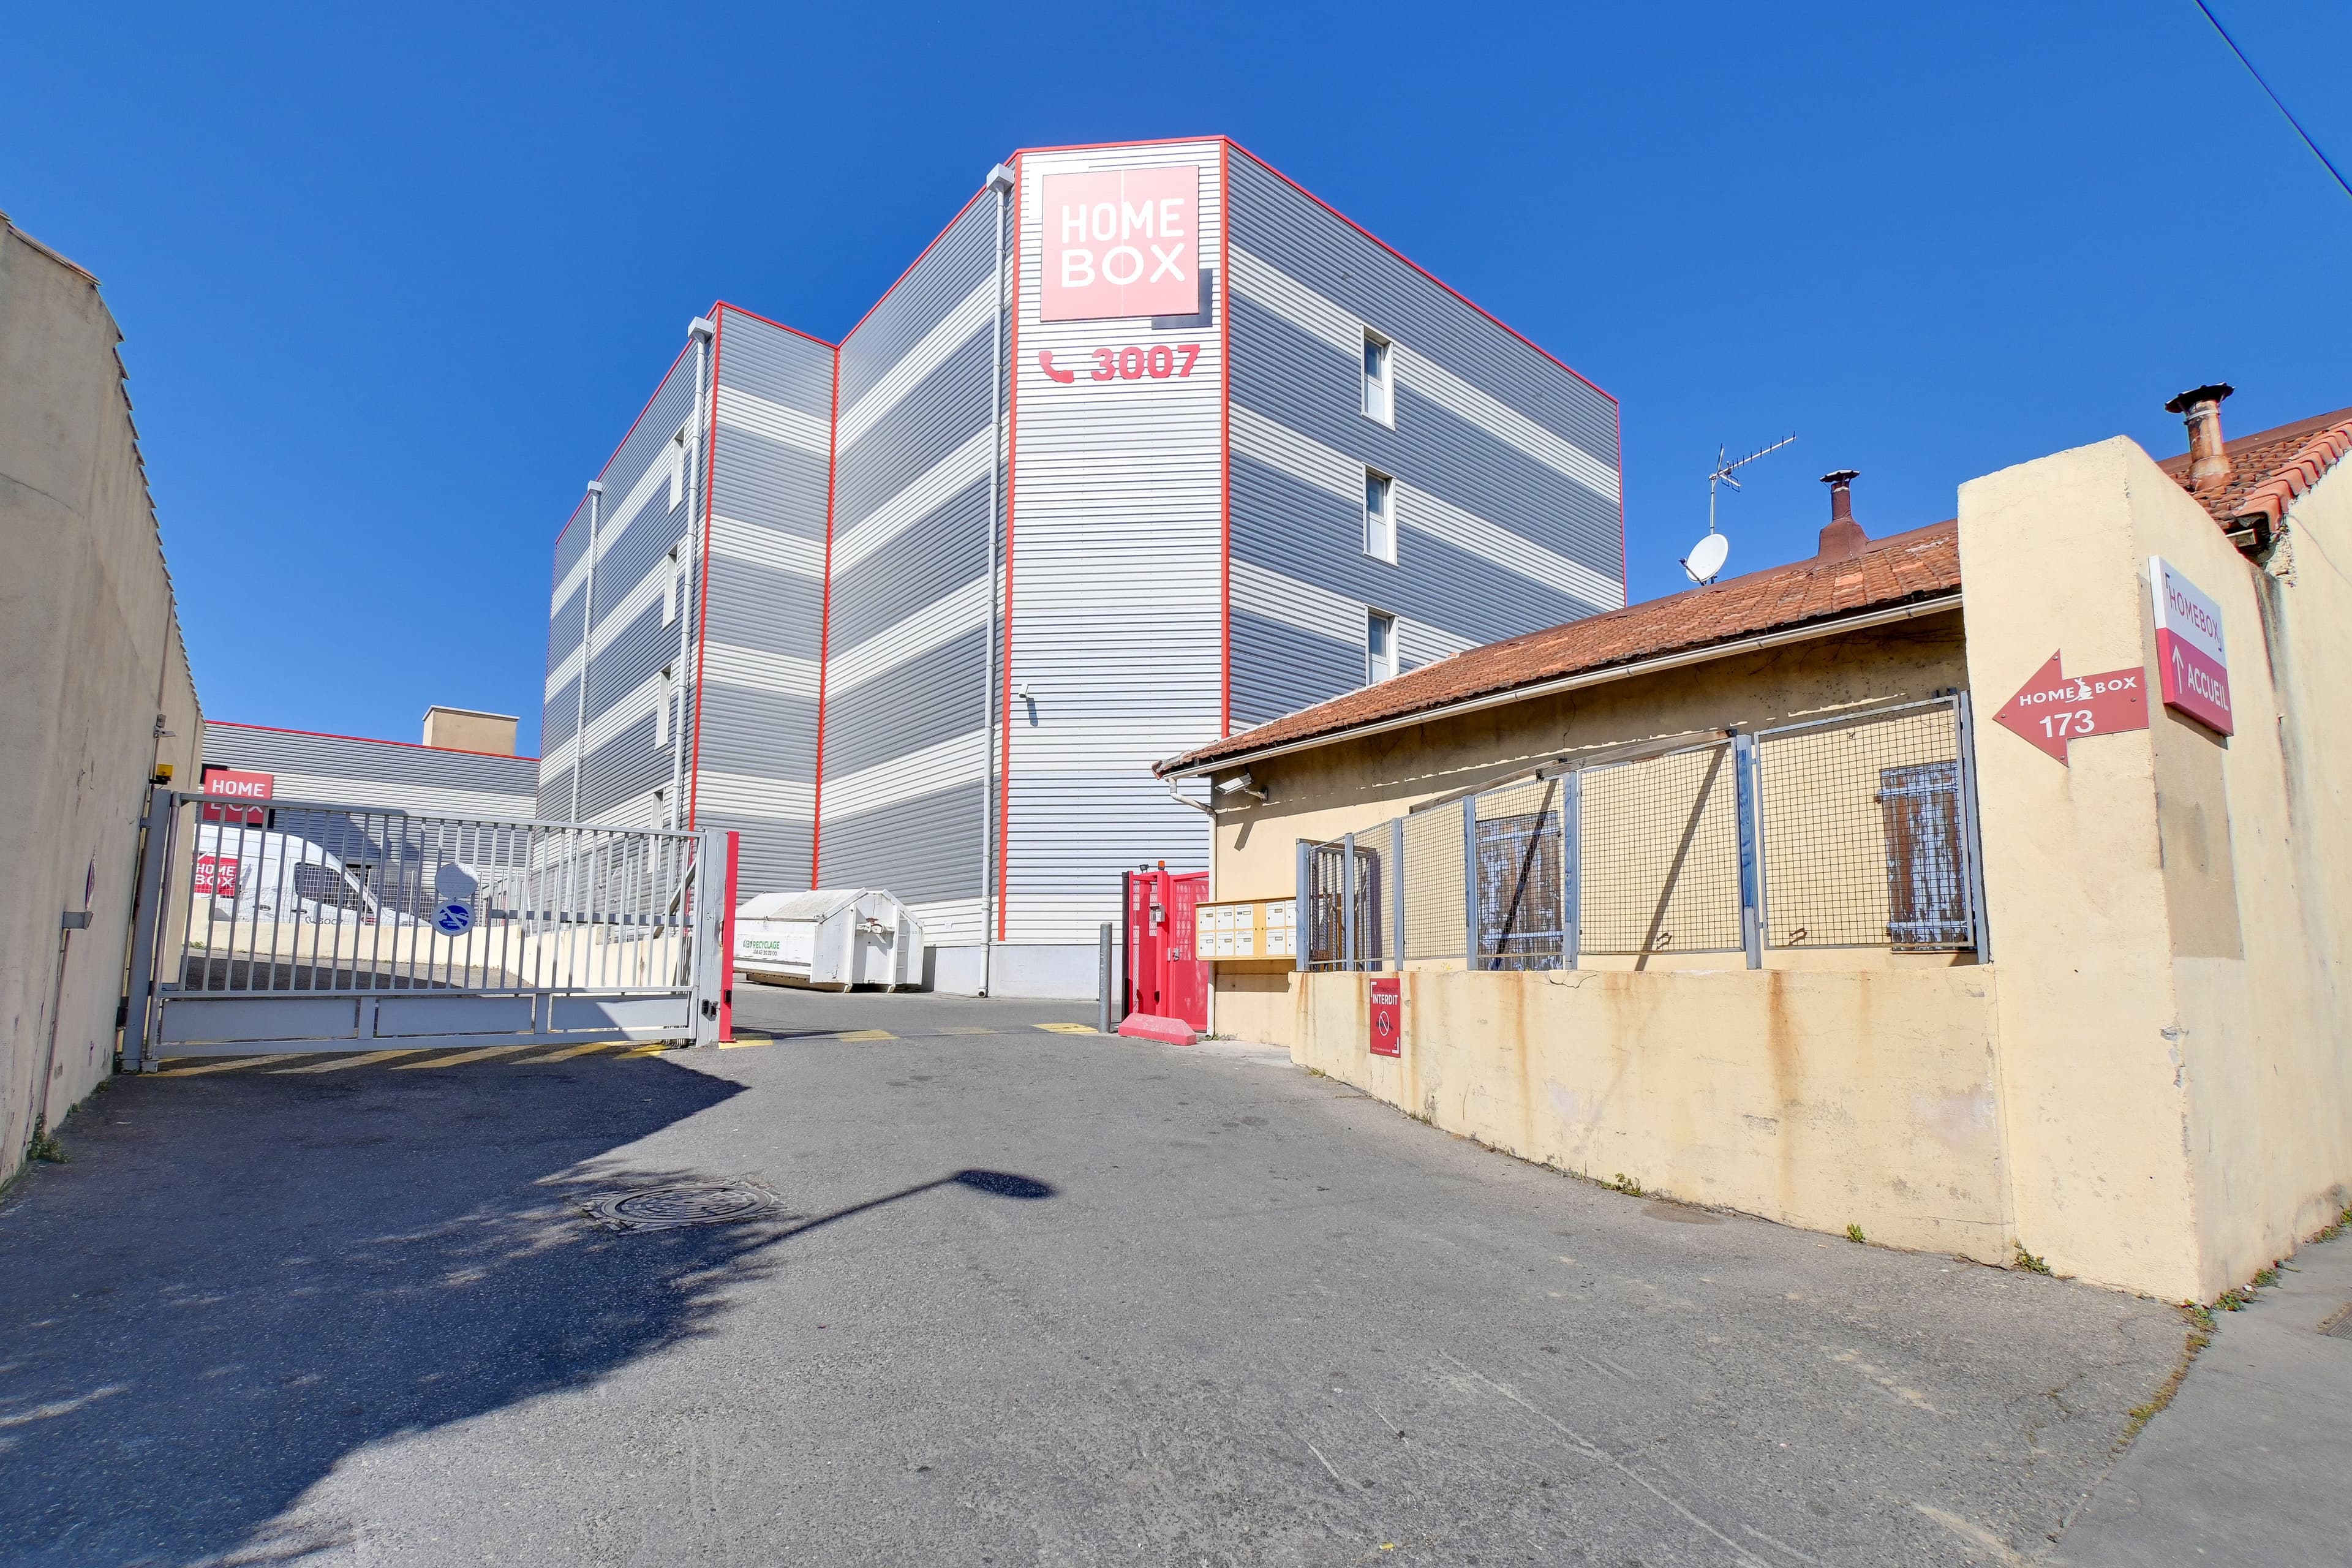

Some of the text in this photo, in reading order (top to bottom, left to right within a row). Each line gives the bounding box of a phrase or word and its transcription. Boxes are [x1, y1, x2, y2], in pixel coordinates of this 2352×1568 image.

[1061, 198, 1185, 243] HOME
[1061, 243, 1185, 288] BOX
[1090, 344, 1200, 381] 3007
[2168, 587, 2220, 641] HOMEBOX
[2019, 676, 2137, 706] HOME BOX
[2187, 663, 2229, 711] ACCUEIL
[2039, 709, 2095, 738] 173
[212, 779, 265, 797] HOME
[753, 941, 780, 949] RECYCLAGE
[1373, 993, 1398, 1005] INTERDIT
